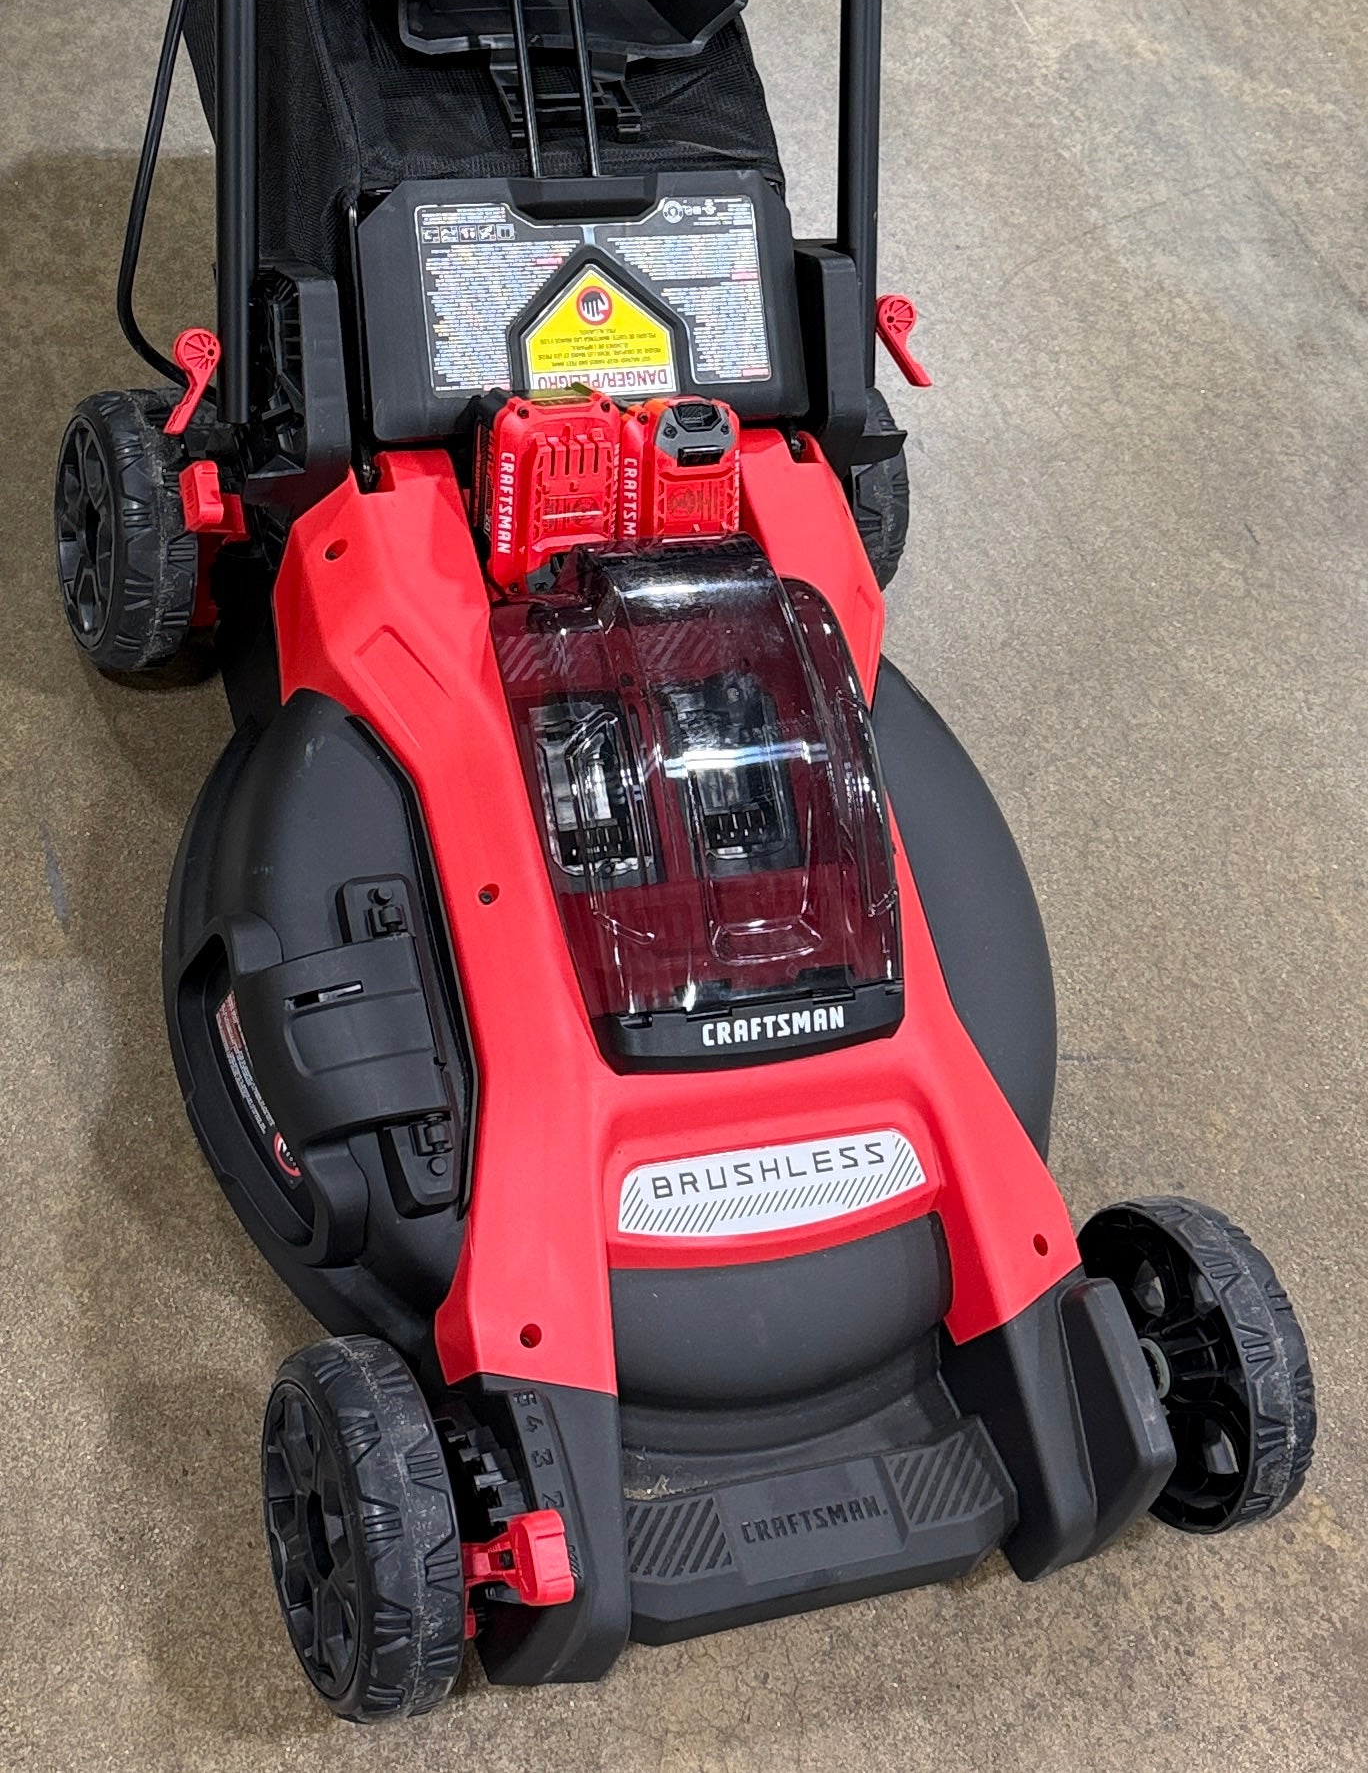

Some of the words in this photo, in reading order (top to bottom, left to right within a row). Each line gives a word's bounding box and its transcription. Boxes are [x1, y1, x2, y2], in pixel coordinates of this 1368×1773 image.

[497, 451, 515, 554] CRAFTSMAN
[623, 457, 638, 538] CRAFTSM
[702, 1005, 845, 1047] CRAFTSMAN
[651, 1141, 886, 1199] BRUSHLESS
[525, 1415, 544, 1433] 4
[531, 1449, 554, 1468] 3
